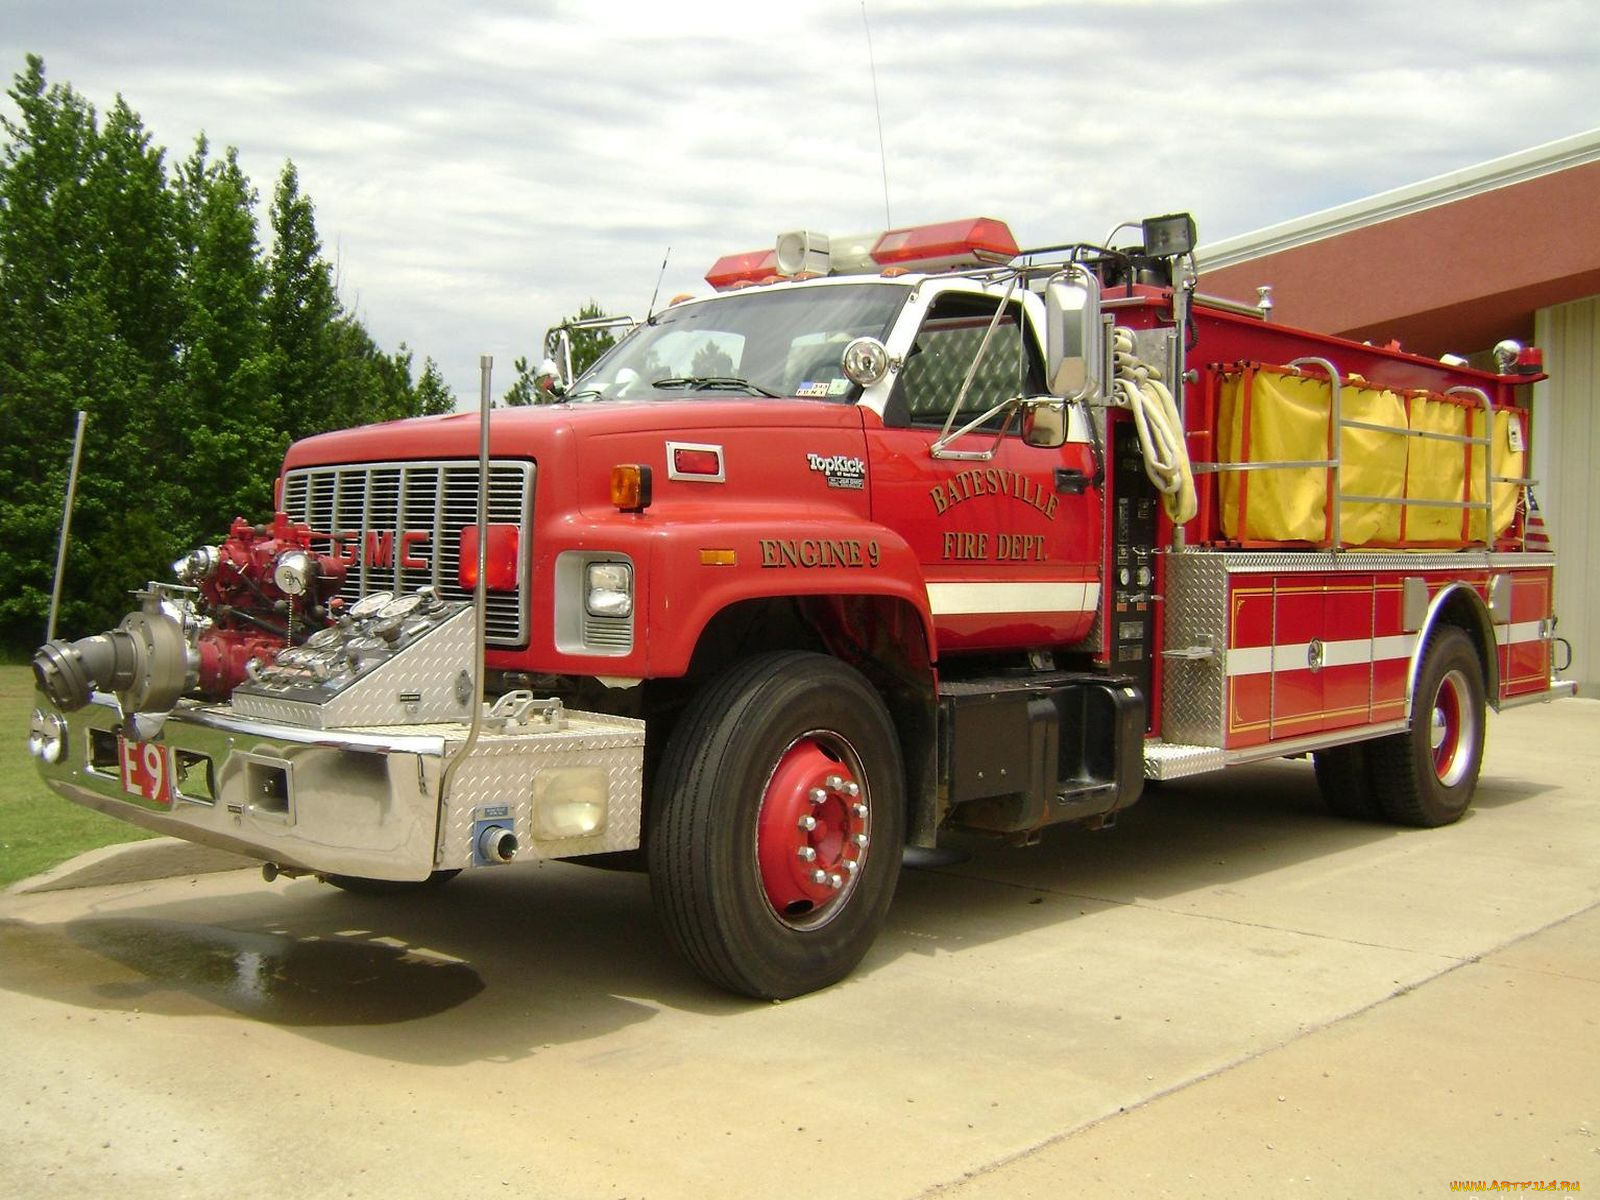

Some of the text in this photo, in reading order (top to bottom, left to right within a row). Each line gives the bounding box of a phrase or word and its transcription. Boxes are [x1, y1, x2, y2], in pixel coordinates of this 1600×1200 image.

[806, 453, 865, 475] TopKick
[930, 468, 1059, 520] BATESVILLE
[334, 529, 430, 569] GMC
[760, 539, 880, 568] ENGINE 9
[943, 531, 1049, 561] FIRE DEPT.
